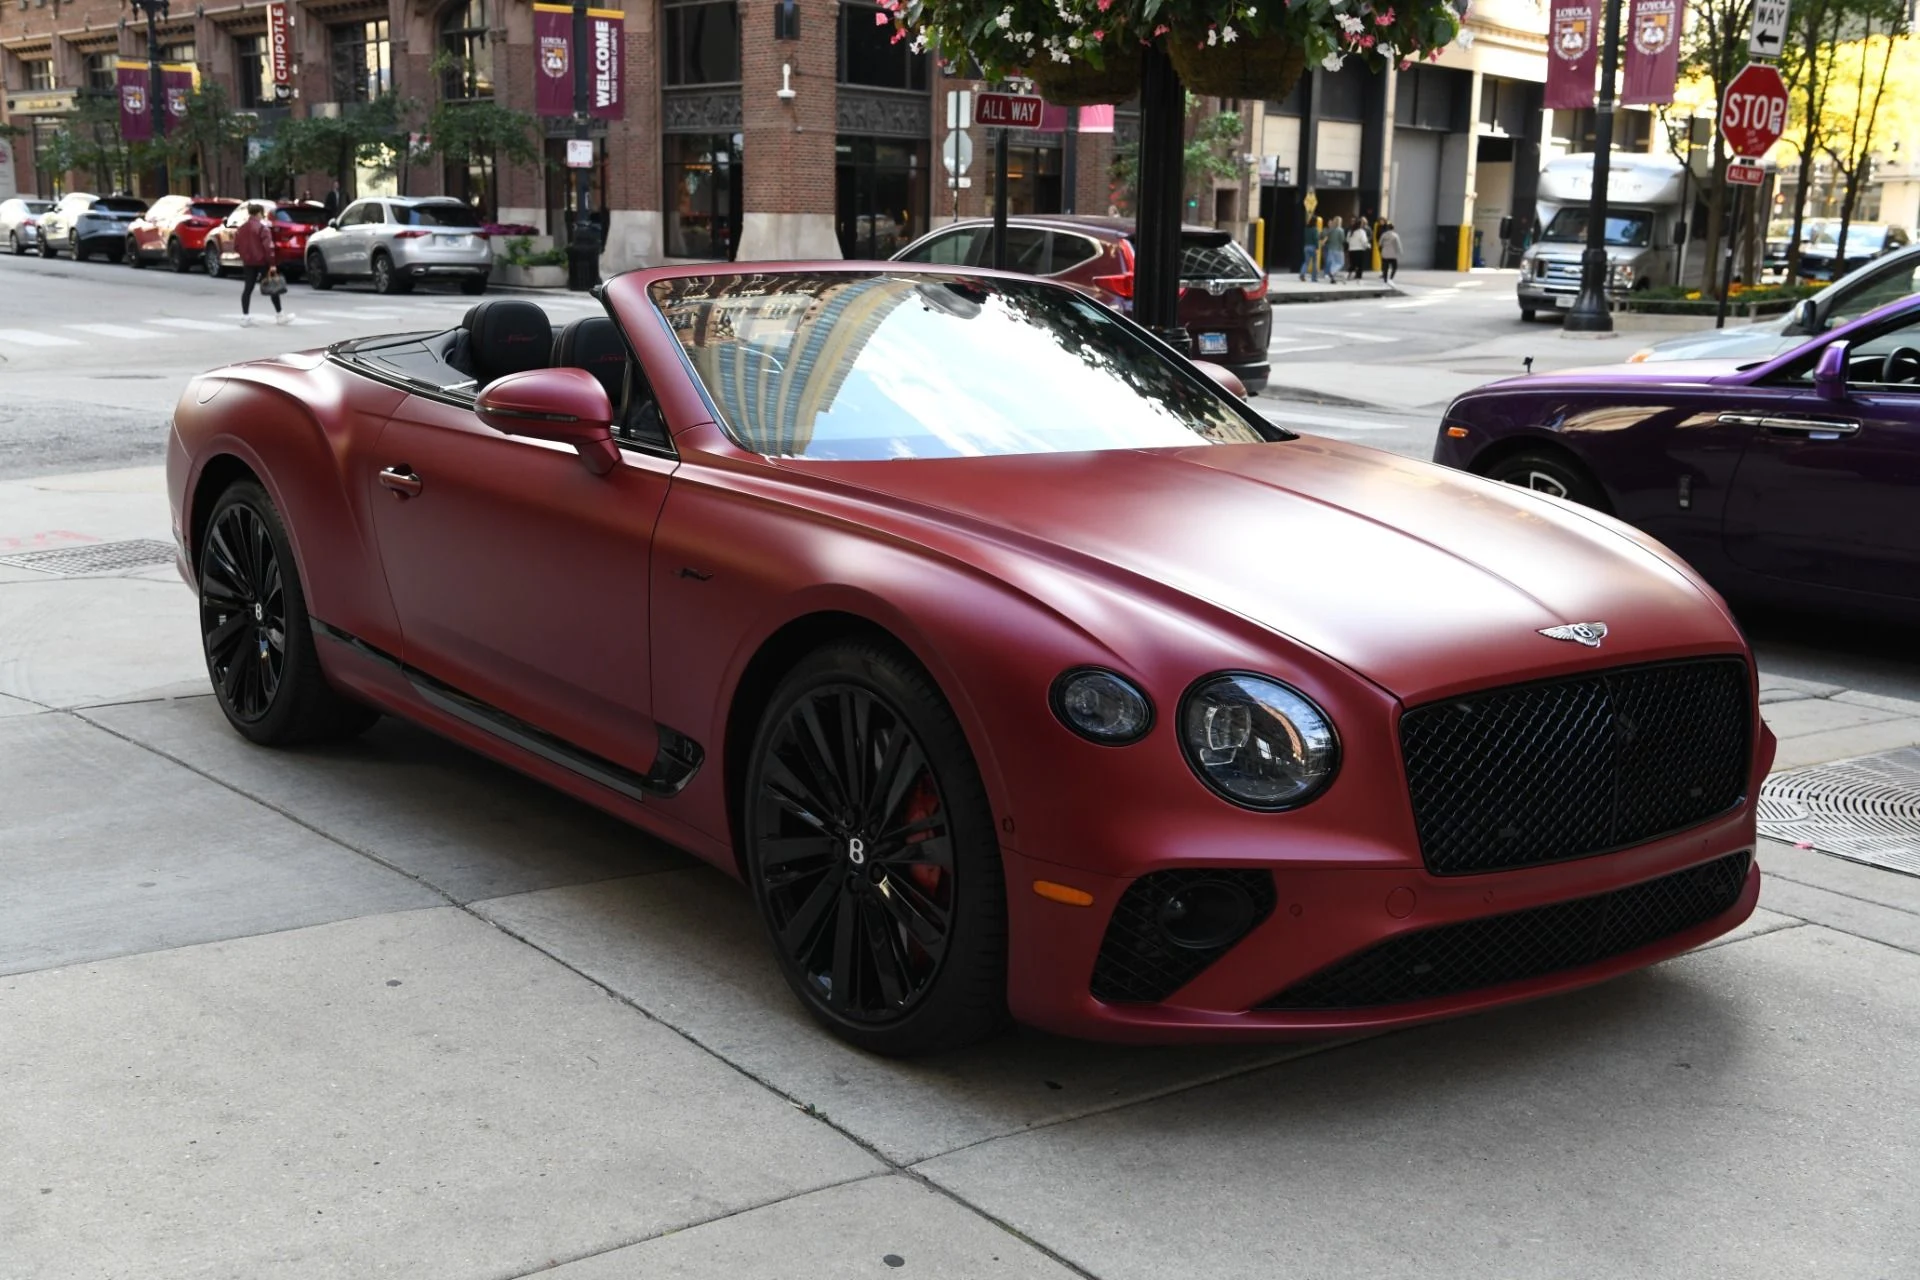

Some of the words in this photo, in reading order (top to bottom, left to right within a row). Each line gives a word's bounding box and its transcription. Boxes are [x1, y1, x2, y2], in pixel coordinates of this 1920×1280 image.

[1555, 6, 1592, 18] LOYOLA
[1636, 0, 1675, 12] LOYOLA
[1757, 7, 1785, 25] WAY
[273, 7, 288, 80] CHIPOTLE
[595, 20, 610, 107] WELCOME
[982, 99, 1006, 120] ALL
[1011, 101, 1036, 122] WAY
[1725, 92, 1785, 131] STOP
[849, 838, 864, 864] B
